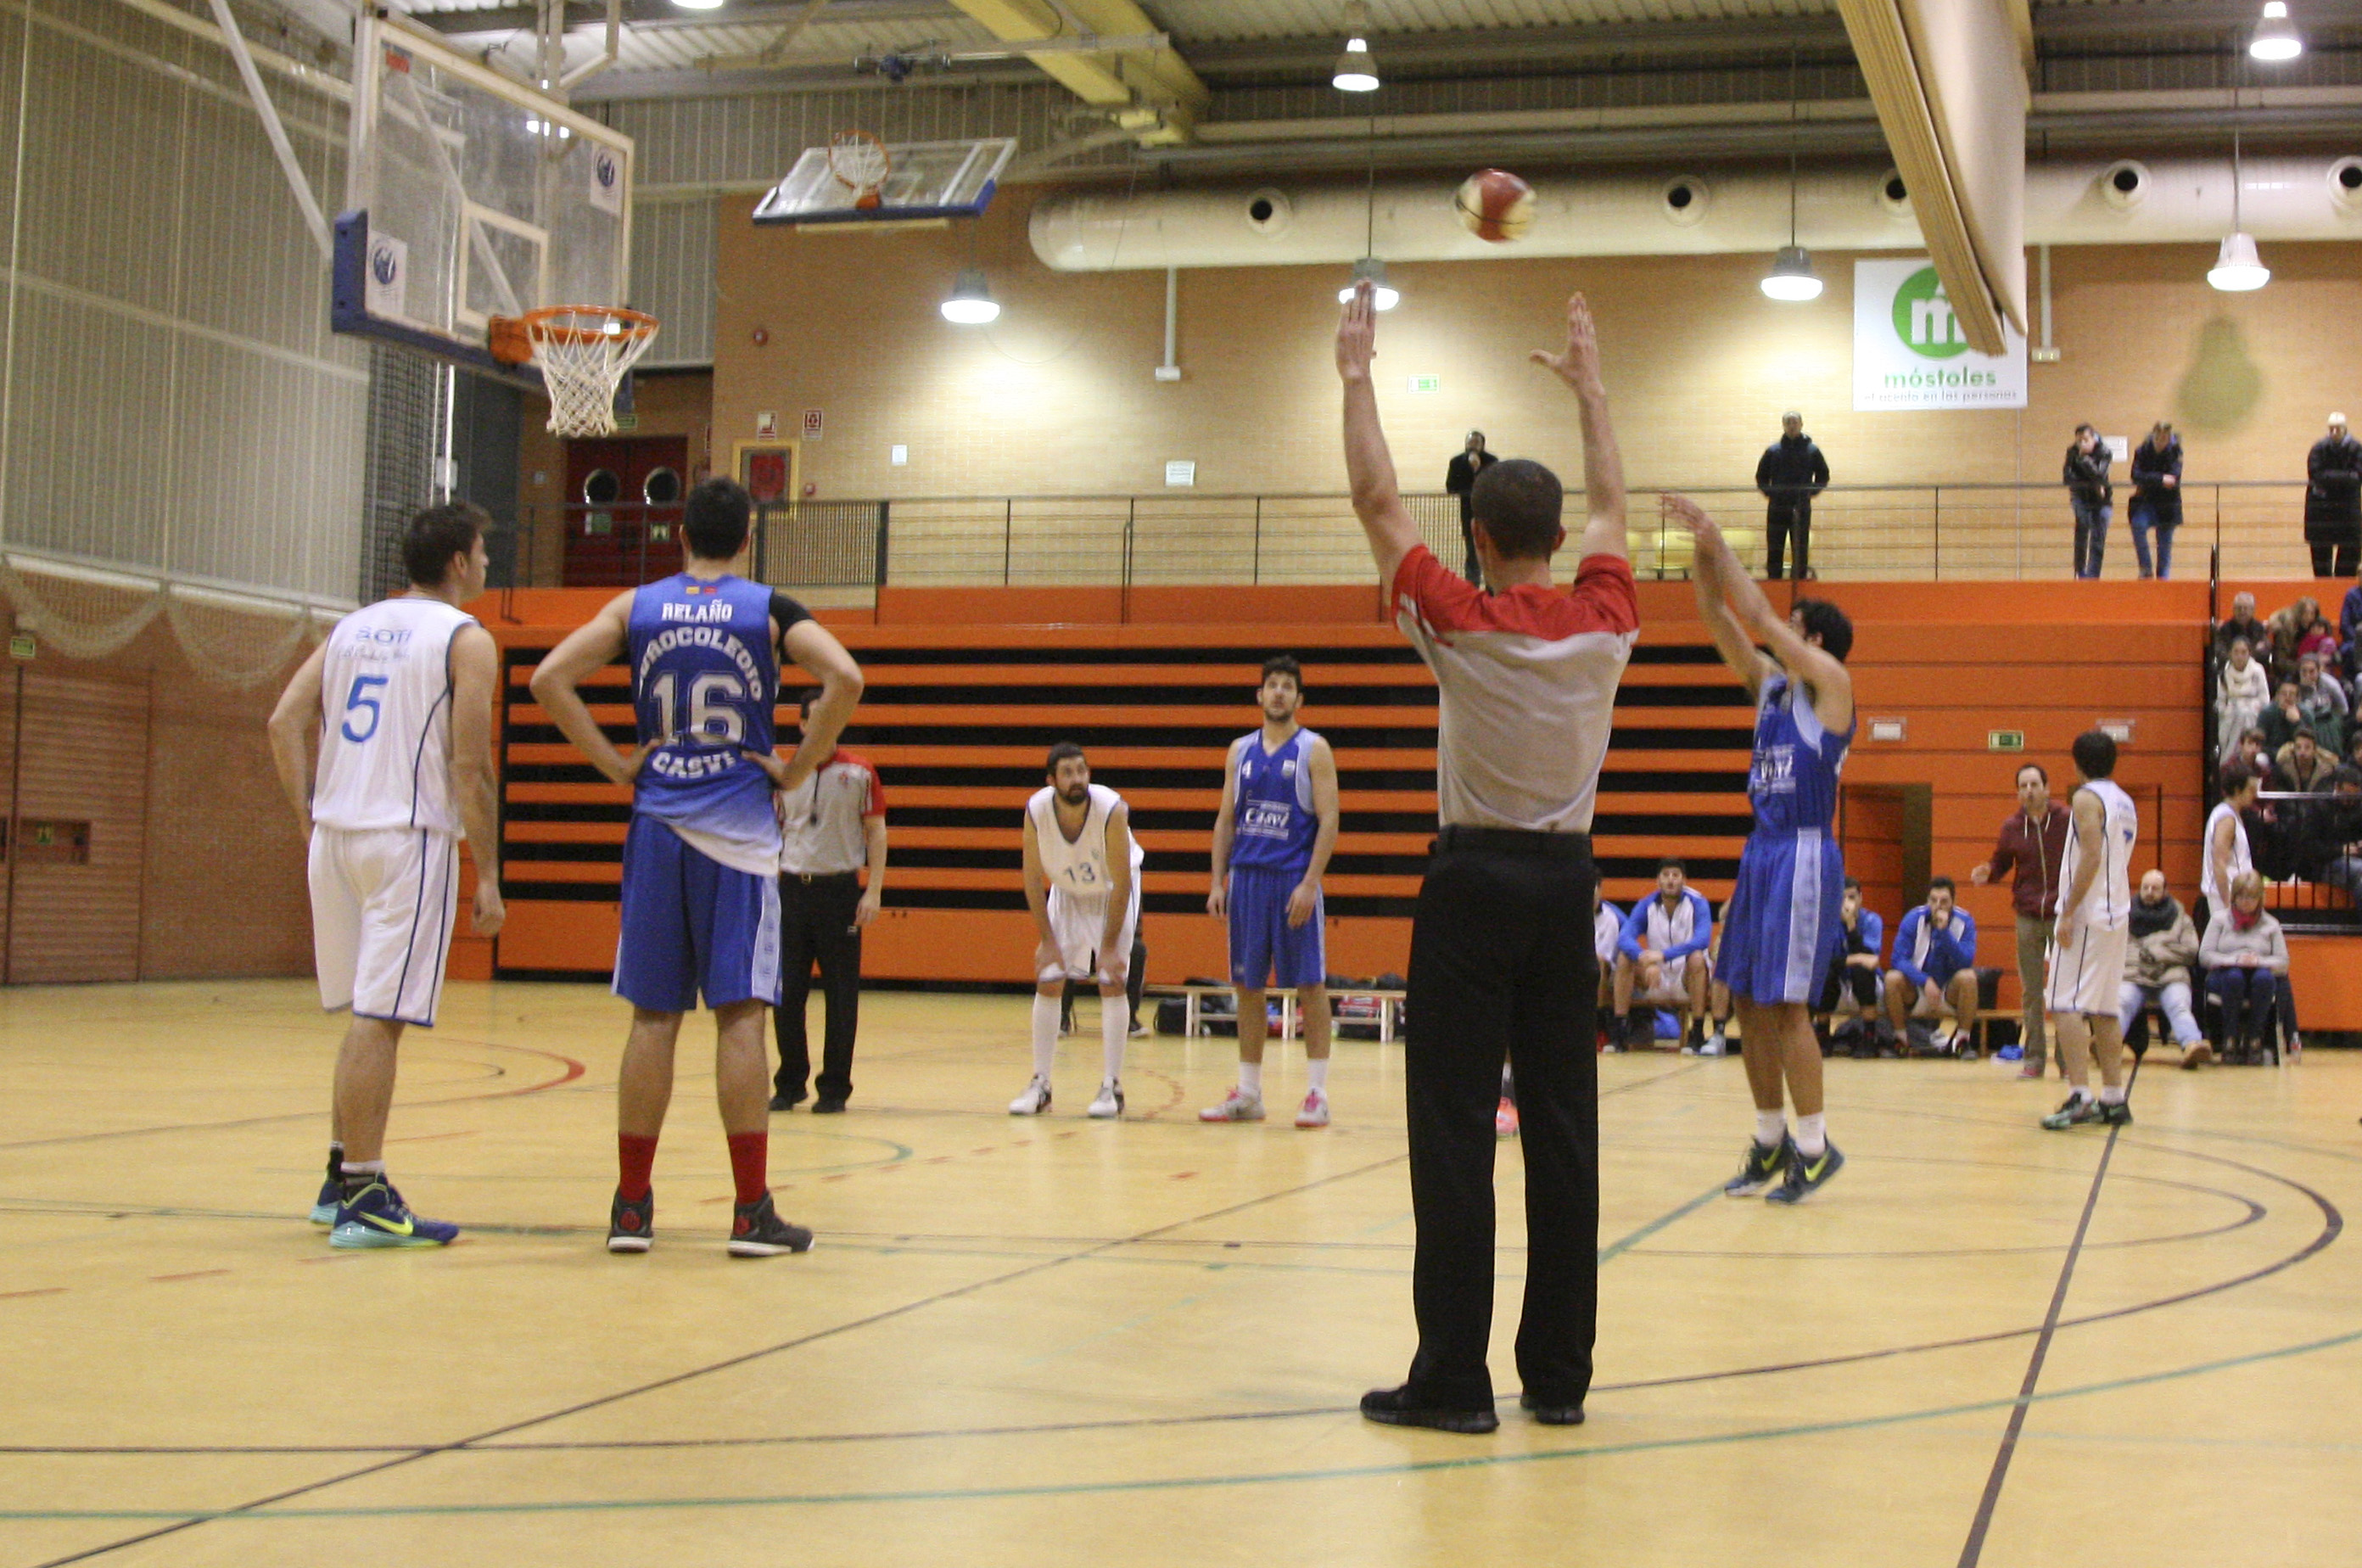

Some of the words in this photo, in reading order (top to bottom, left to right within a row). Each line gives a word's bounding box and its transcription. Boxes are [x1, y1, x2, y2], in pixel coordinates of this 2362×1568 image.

[1884, 366, 1997, 389] móstoles
[661, 598, 734, 624] RELAÑO
[341, 675, 389, 743] 5
[649, 669, 747, 746] 16
[1241, 759, 1253, 780] 4
[1062, 861, 1096, 884] 13
